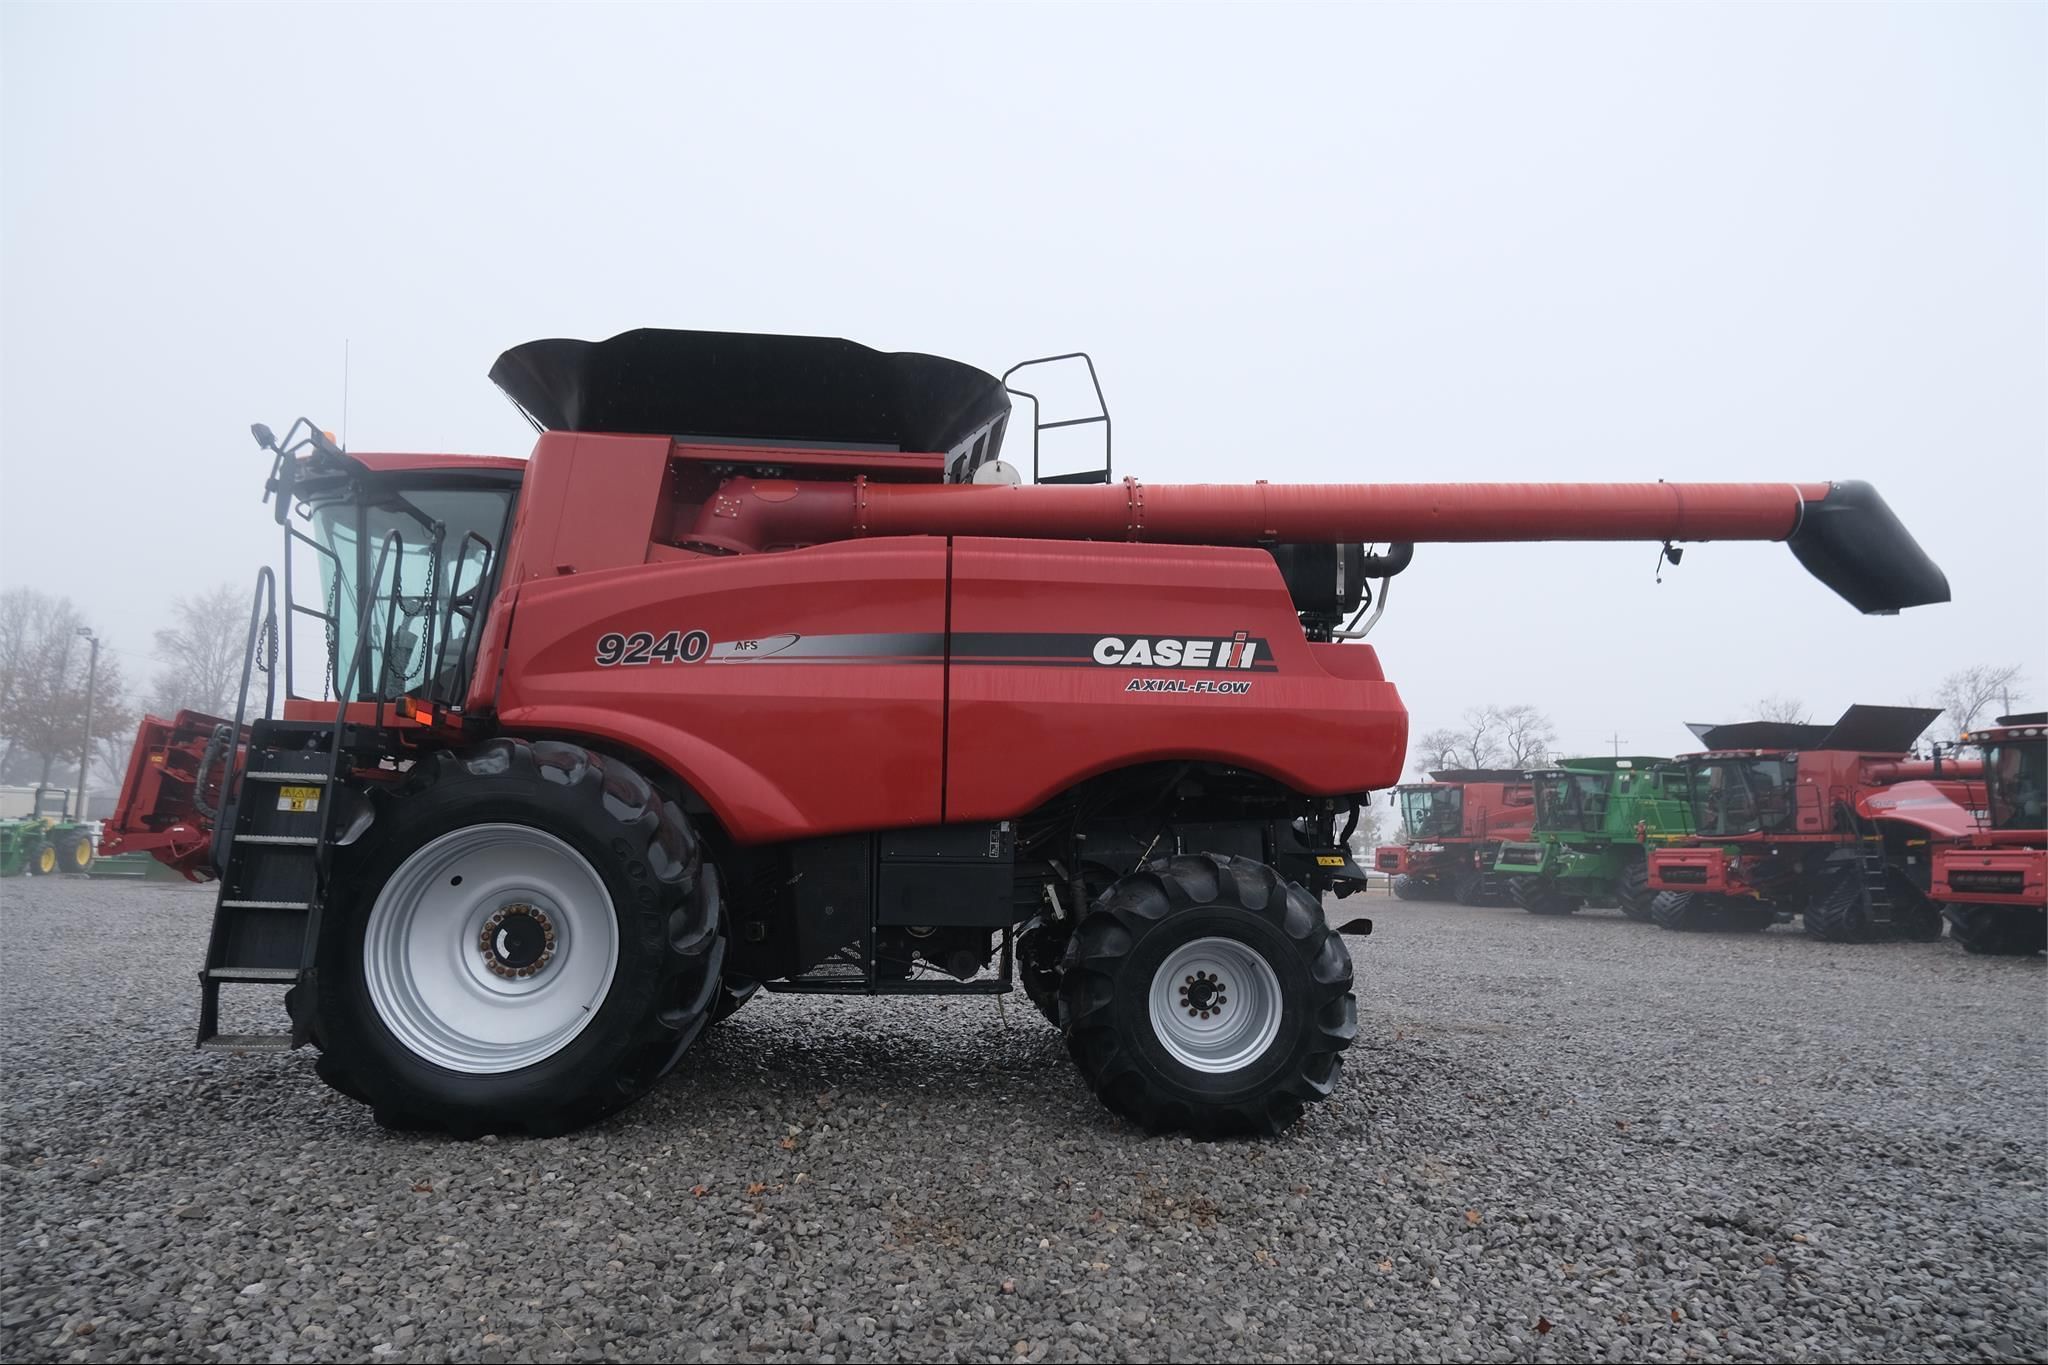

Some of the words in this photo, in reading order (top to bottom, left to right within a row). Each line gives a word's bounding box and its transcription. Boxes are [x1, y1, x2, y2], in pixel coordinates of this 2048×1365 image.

[595, 629, 710, 667] 9240
[735, 640, 758, 651] AFS
[1093, 637, 1214, 667] CASE
[1125, 678, 1252, 694] AXIAL-FLOW
